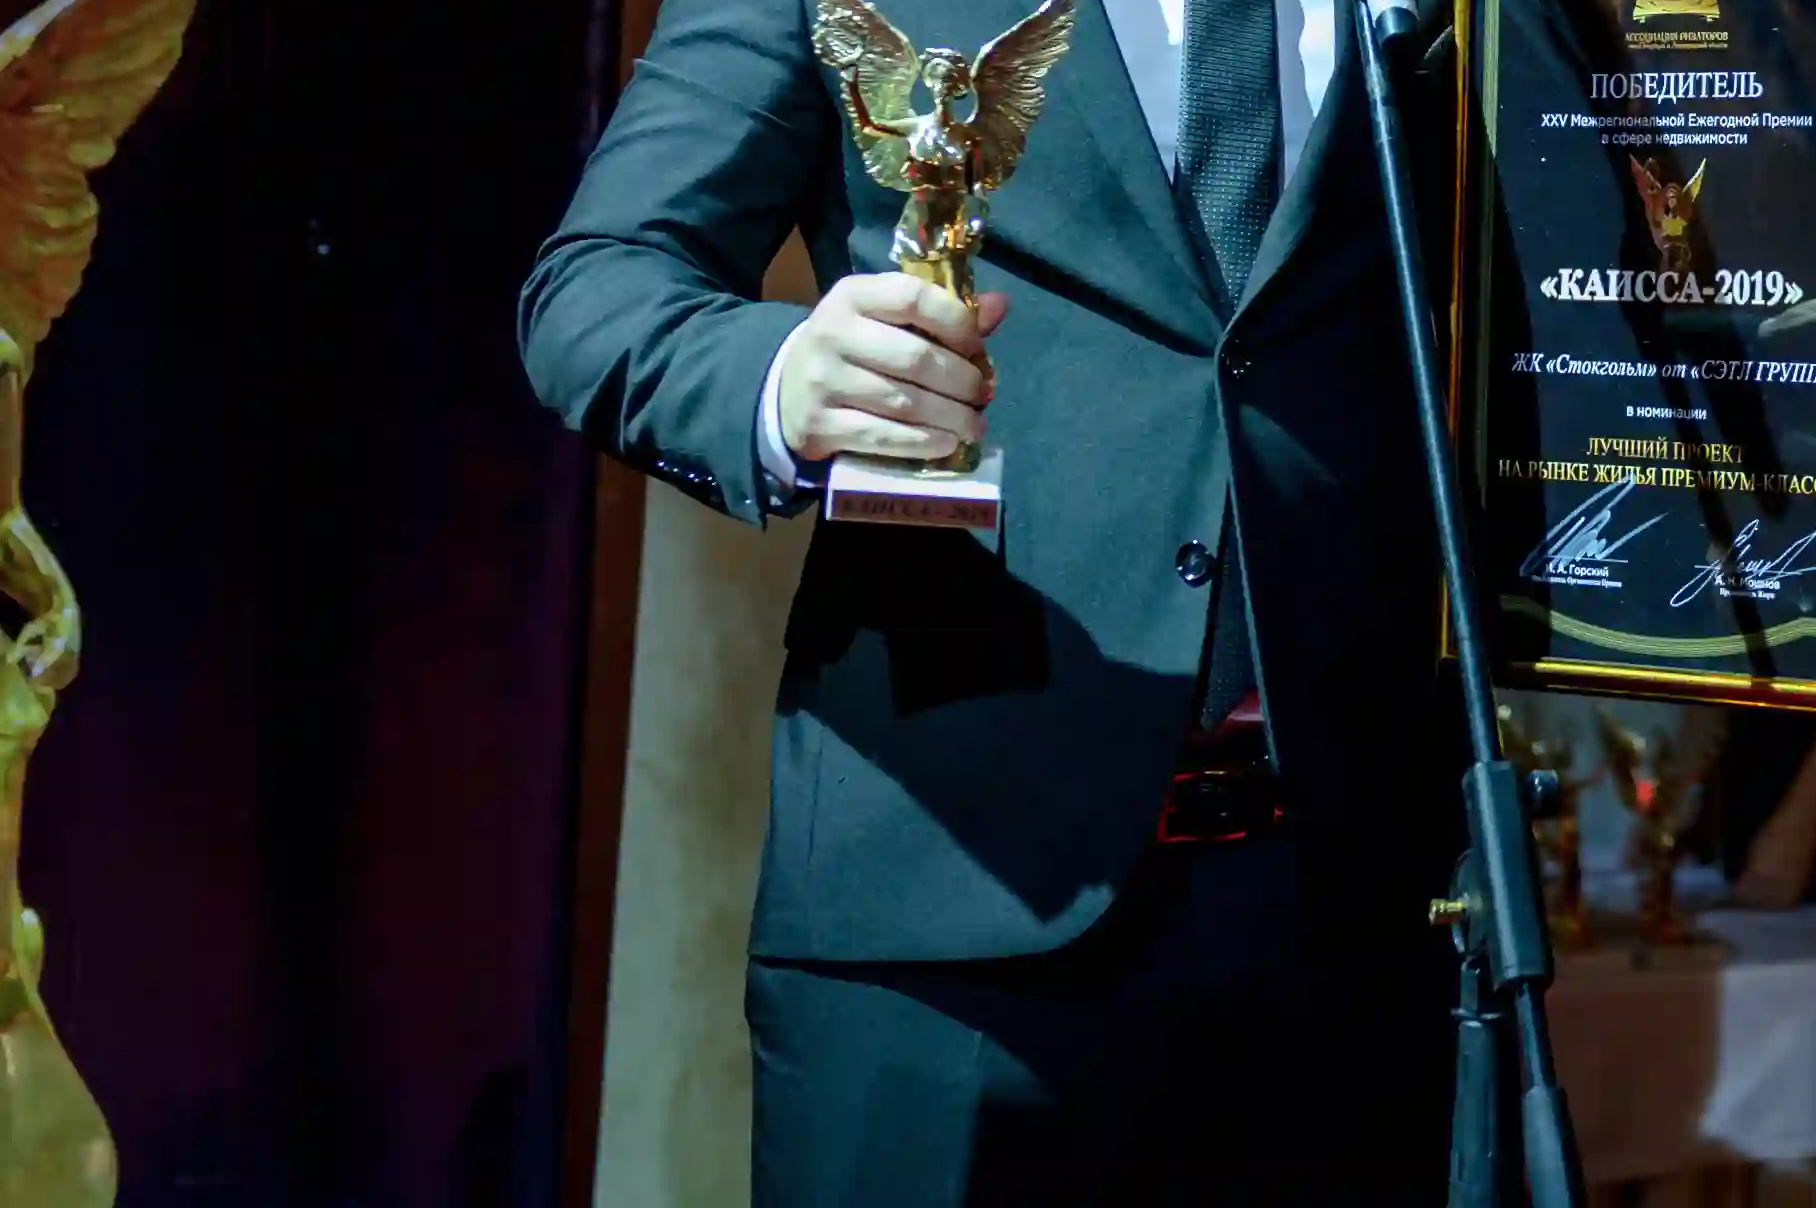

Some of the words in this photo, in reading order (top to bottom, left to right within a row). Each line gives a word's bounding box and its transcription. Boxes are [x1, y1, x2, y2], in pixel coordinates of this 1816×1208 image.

[1589, 72, 1763, 104] ПОБЕДИТЕЛЬ
[1541, 113, 1568, 128] XXV
[1570, 113, 1685, 129] Межрегиональной
[1688, 112, 1760, 129] Ежегодной
[1762, 112, 1813, 129] Премии
[1613, 132, 1653, 148] сфере
[1655, 133, 1748, 147] недвижимости
[1540, 268, 1804, 307] «КАИССА-2019»
[1511, 352, 1545, 373] ЖК
[1546, 354, 1657, 377] «Стокгольм»
[1661, 363, 1688, 379] от
[1690, 359, 1754, 381] «СЭТЛ
[1636, 406, 1707, 420] номинации
[1586, 436, 1668, 461] ЛУЧШИЙ
[1671, 441, 1744, 464] ПРОЕКТ
[1498, 458, 1524, 478] НА
[1527, 459, 1589, 482] РЫНКЕ
[1592, 463, 1657, 486] ЖИЛЬЯ
[1569, 563, 1609, 577] Горский
